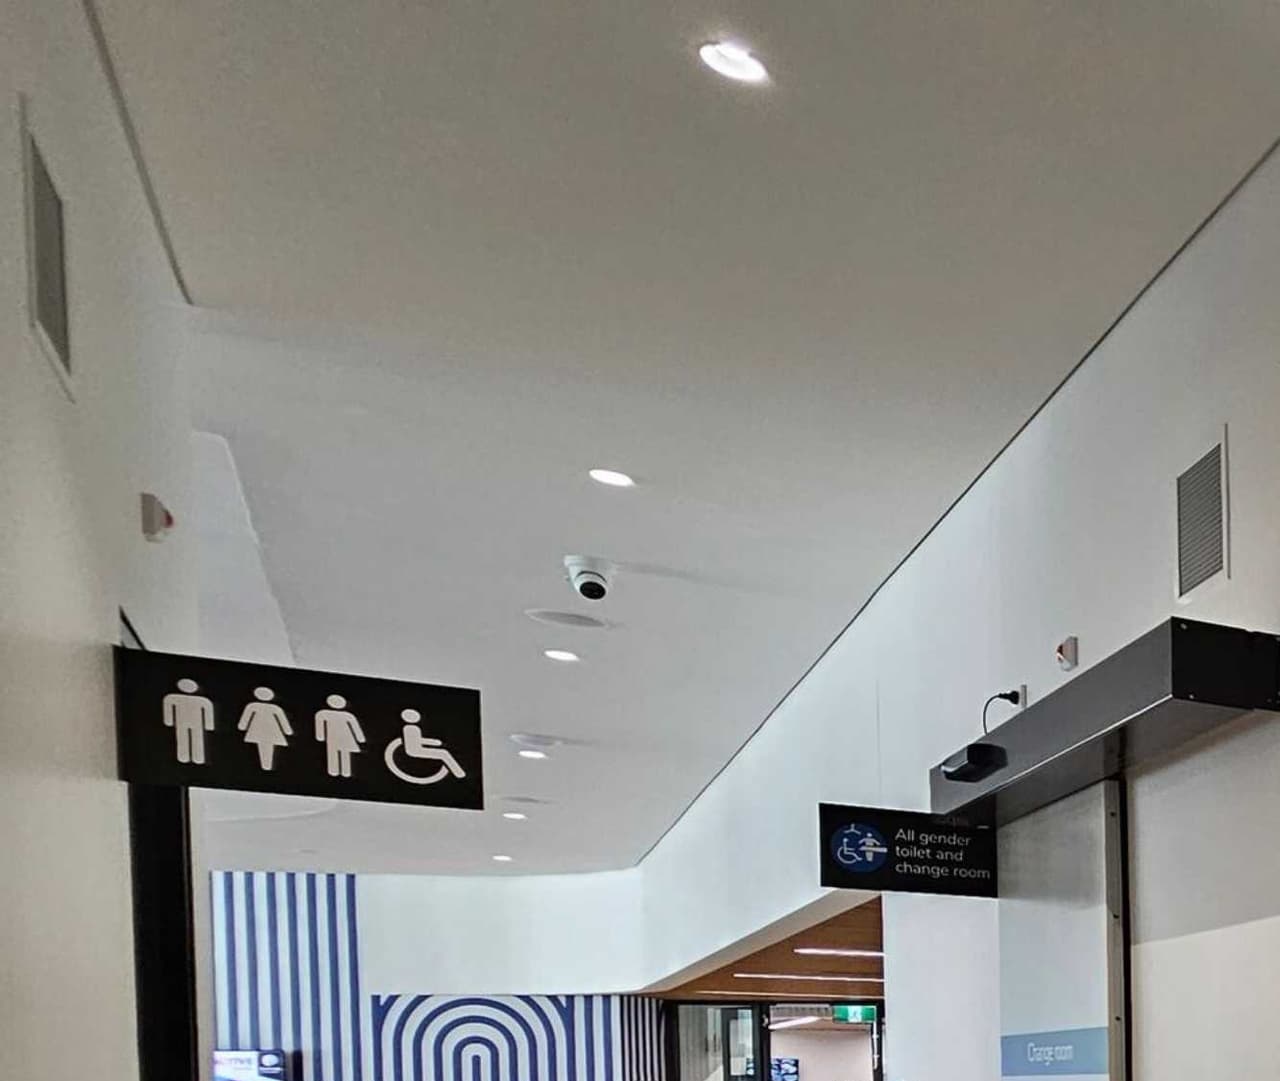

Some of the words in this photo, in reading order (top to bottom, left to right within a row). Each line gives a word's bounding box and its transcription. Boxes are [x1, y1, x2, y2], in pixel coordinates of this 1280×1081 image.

[895, 828, 915, 842] All
[919, 833, 971, 846] gender
[895, 845, 932, 859] toilet
[935, 849, 963, 862] and
[895, 861, 950, 878] change
[953, 867, 990, 880] room
